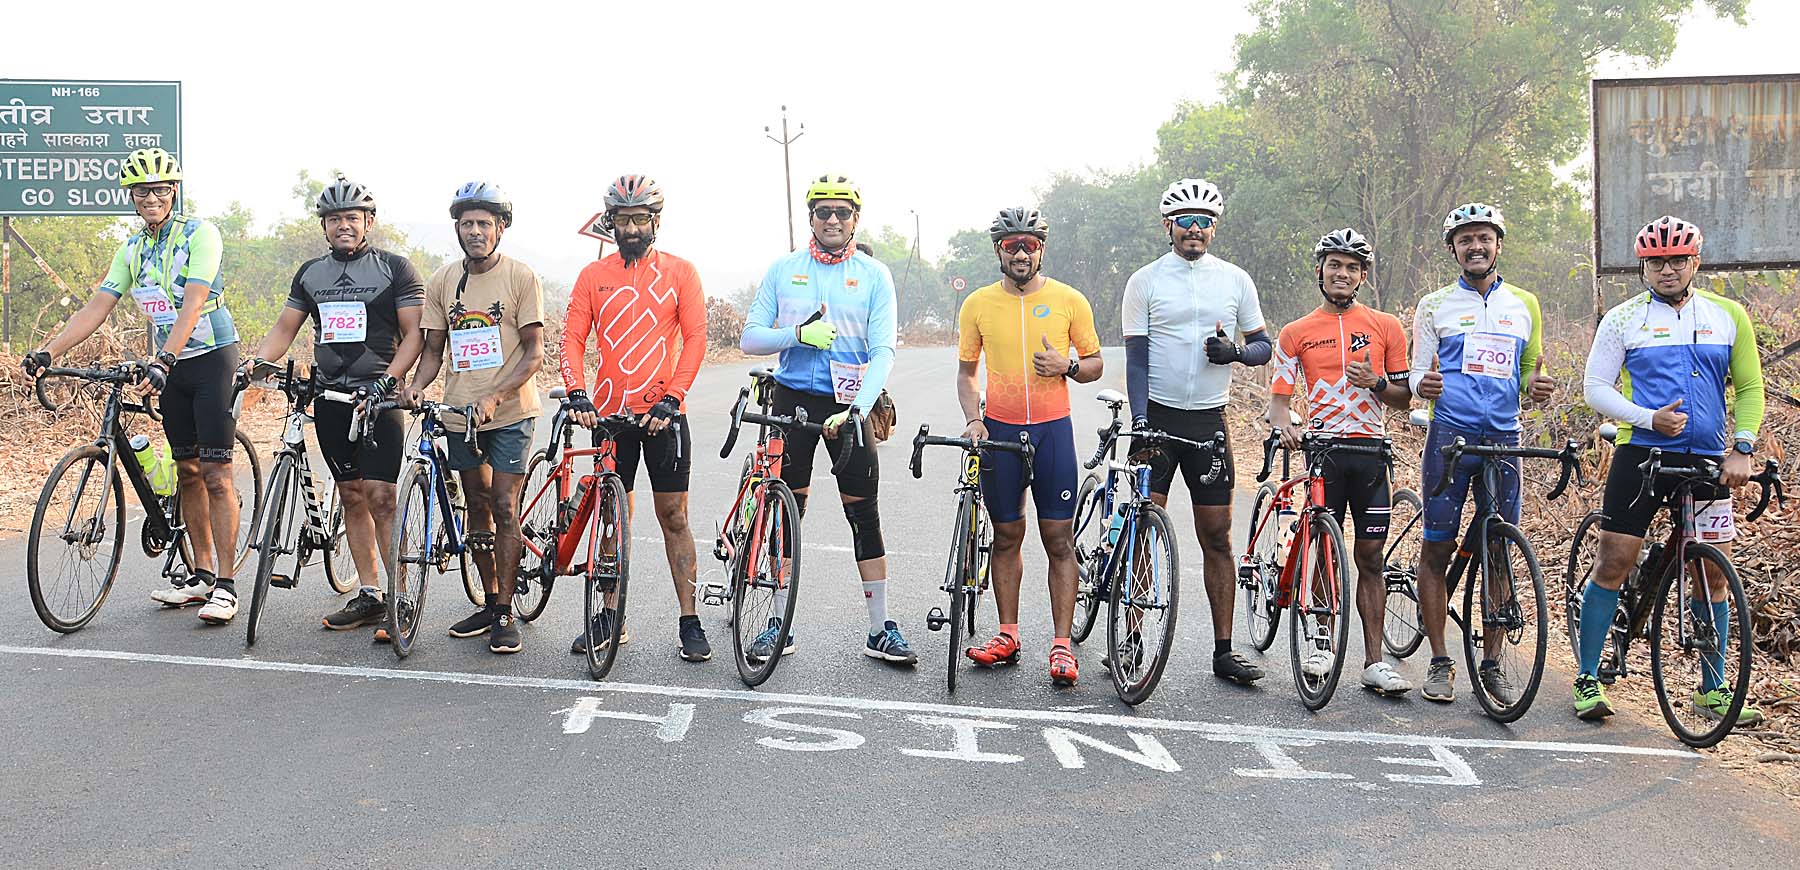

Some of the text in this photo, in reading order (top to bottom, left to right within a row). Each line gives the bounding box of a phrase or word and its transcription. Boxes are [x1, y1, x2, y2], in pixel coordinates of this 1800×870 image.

[51, 87, 100, 97] NH-166
[81, 106, 154, 126] उतार
[42, 133, 110, 148] सावकाश
[123, 133, 162, 148] हाका
[21, 188, 131, 206] GO SLOW
[314, 287, 378, 298] MERIDA
[143, 300, 167, 313] 778
[328, 317, 356, 329] 782
[460, 342, 490, 357] 753
[1476, 349, 1507, 364] 730
[1709, 515, 1731, 529] 72
[551, 696, 1482, 787] FINISH
